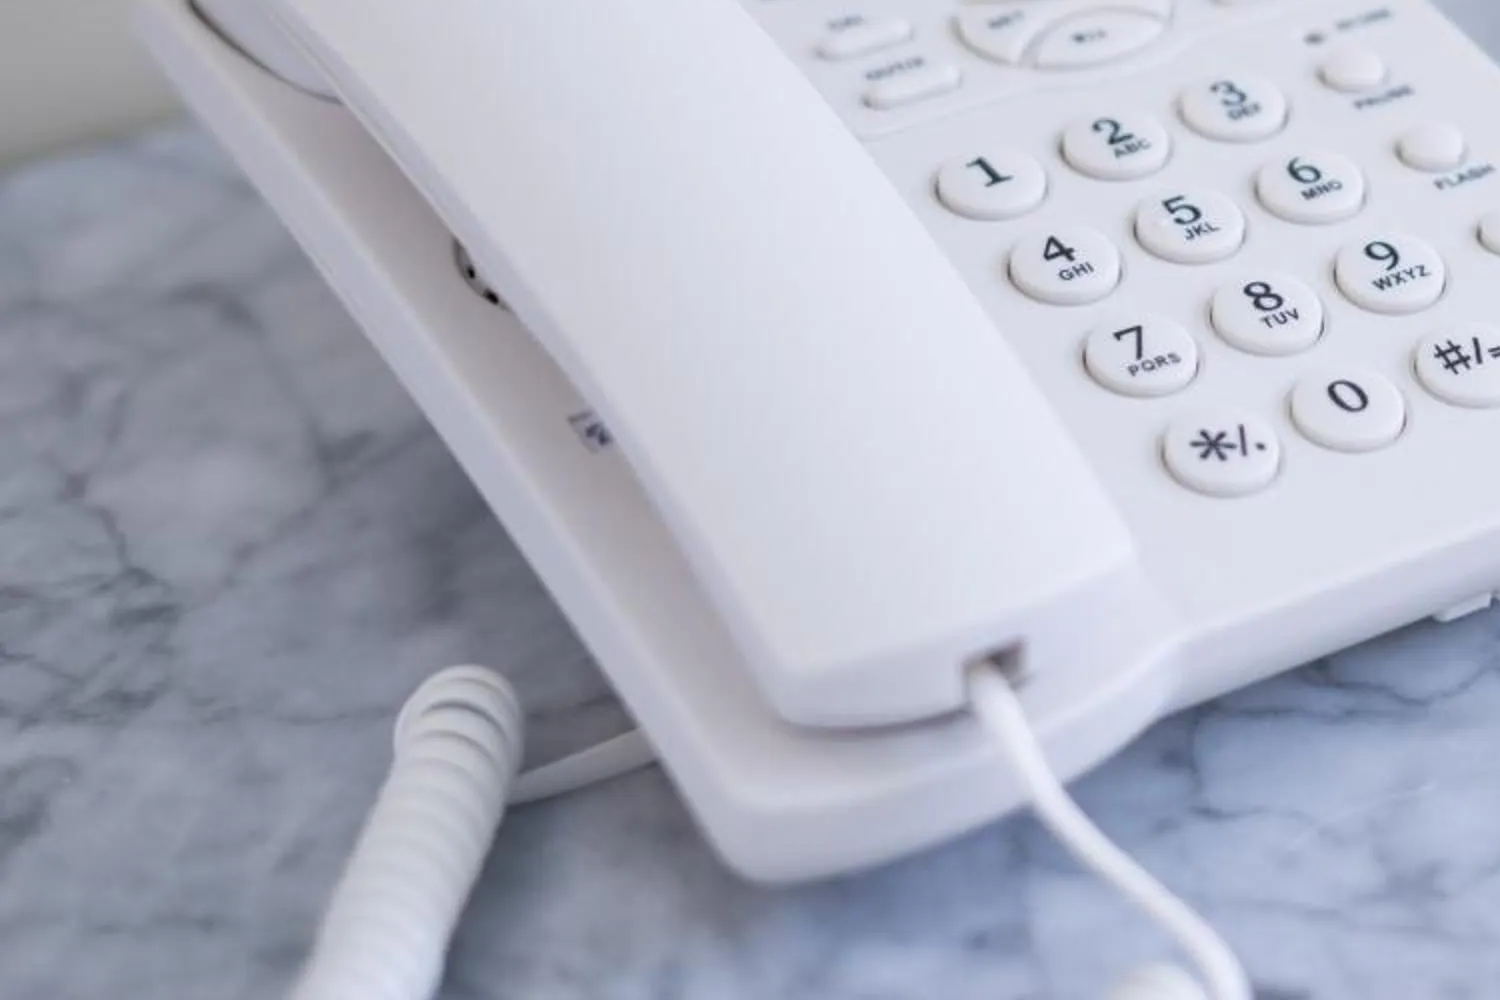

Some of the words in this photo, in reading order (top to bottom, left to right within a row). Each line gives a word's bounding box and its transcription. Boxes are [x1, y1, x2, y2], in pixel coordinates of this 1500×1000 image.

[1209, 81, 1247, 107] 3
[1091, 116, 1134, 145] 2
[1113, 137, 1152, 158] ABC
[966, 156, 1013, 188] 1
[1286, 156, 1322, 184] 6
[1433, 163, 1497, 190] FLASH
[1300, 179, 1343, 200] MNO
[1162, 195, 1202, 225] 5
[1183, 221, 1221, 241] JKL
[1043, 235, 1076, 262] 4
[1364, 241, 1400, 271] 9
[1058, 261, 1095, 281] GHI
[1372, 263, 1432, 292] WXYZ
[1243, 281, 1284, 312] 8
[1259, 307, 1300, 329] TUV
[1112, 324, 1145, 361] 7
[1127, 352, 1182, 376] PQRS
[1327, 379, 1369, 413] 0
